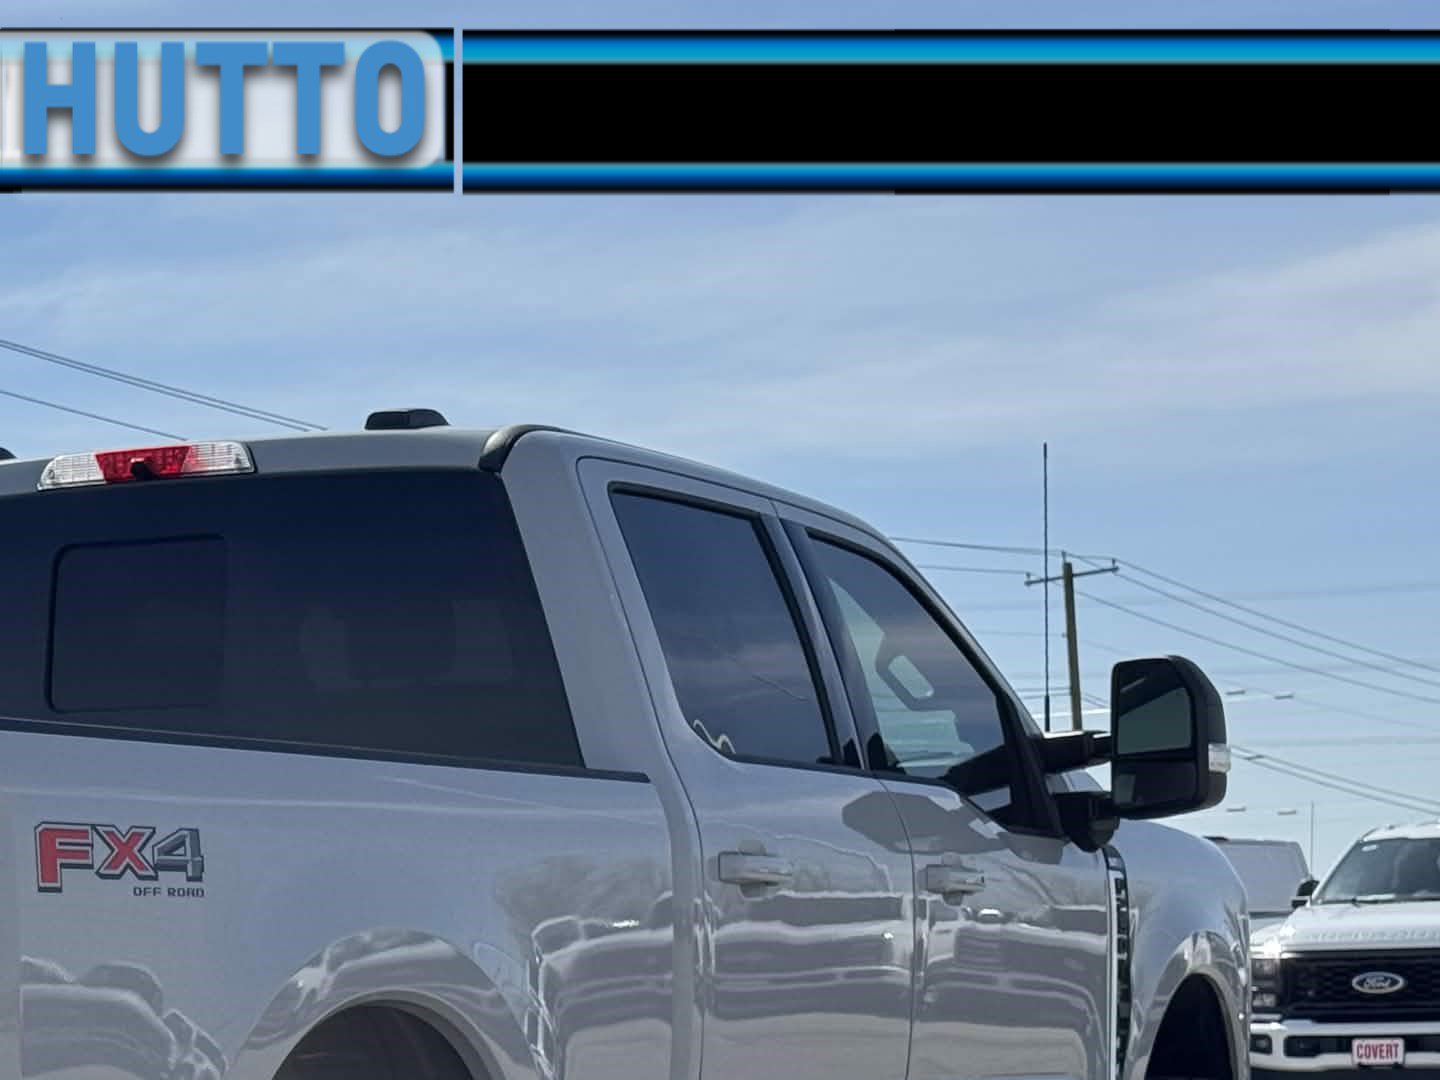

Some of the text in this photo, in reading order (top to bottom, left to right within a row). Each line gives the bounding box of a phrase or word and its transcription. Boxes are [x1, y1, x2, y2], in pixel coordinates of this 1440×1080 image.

[34, 821, 205, 893] FX4
[133, 886, 205, 898] OFF ROAD
[1356, 1042, 1400, 1060] COVERT
